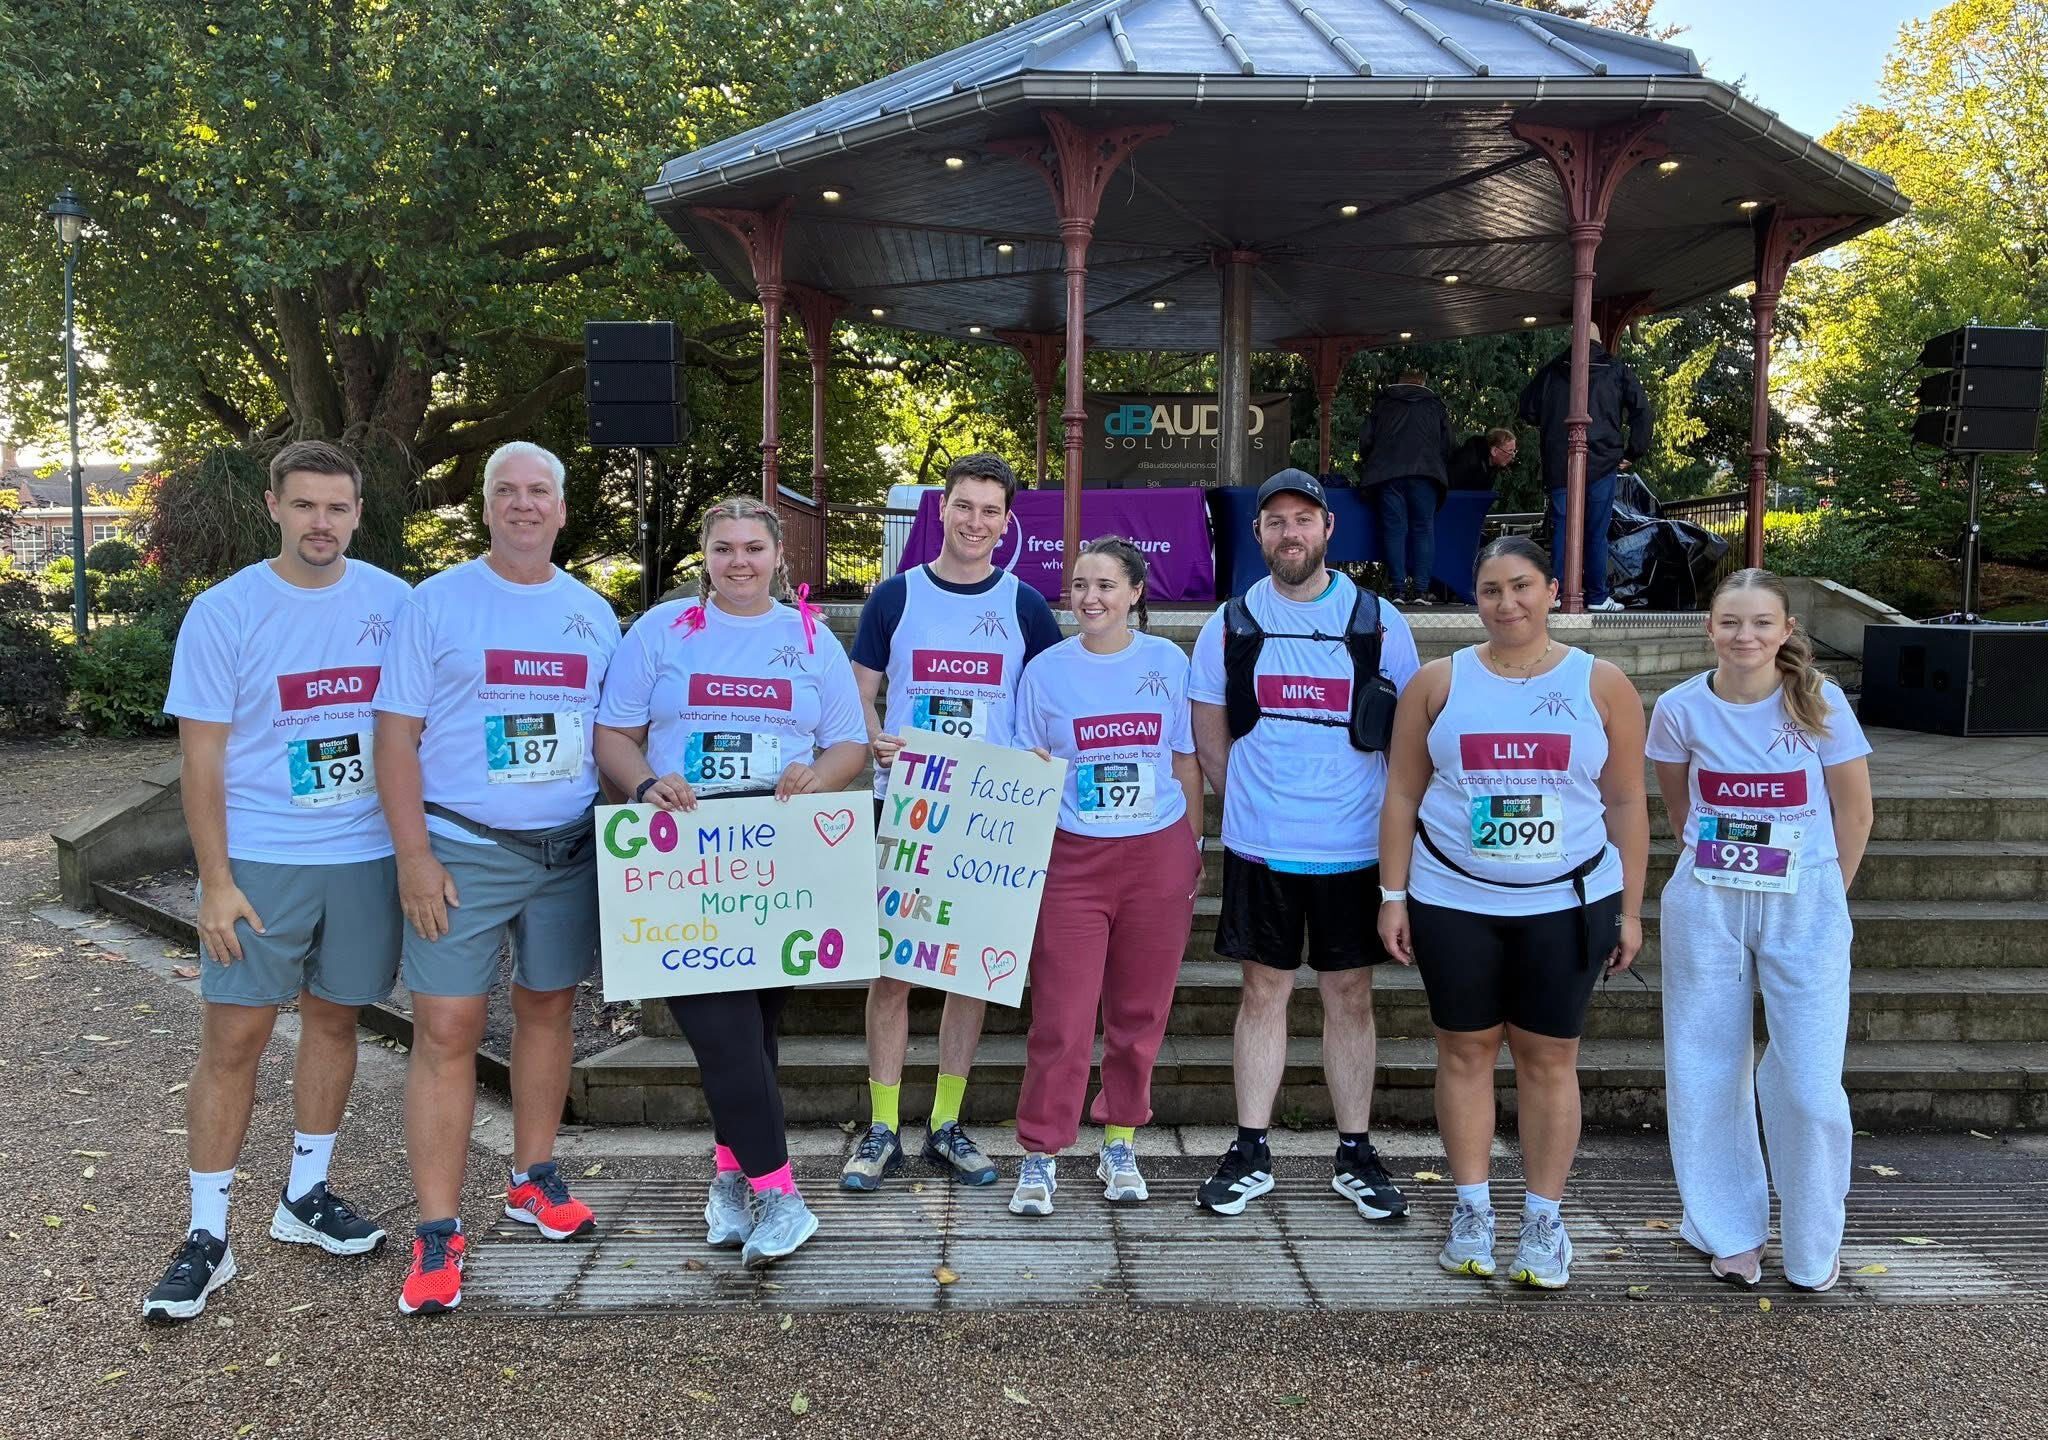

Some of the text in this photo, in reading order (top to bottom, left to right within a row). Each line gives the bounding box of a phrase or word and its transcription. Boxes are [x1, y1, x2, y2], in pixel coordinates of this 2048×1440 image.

[1104, 404, 1265, 436] dBAUDO
[1138, 461, 1217, 470] dBaudiosolutions.co
[513, 659, 564, 677] MIKE
[927, 658, 989, 675] JACOB
[306, 676, 363, 699] BRAD
[477, 689, 591, 704] katharine house hospi
[706, 682, 778, 699] CESCA
[906, 686, 1007, 700] katharine house hospice
[1282, 684, 1326, 702] MIKE
[272, 713, 320, 728] katharne
[324, 710, 355, 721] house
[679, 711, 797, 727] katharine house hospice
[1080, 721, 1158, 741] MORGAN
[507, 738, 559, 765] 187
[1075, 753, 1111, 764] atharine
[1114, 751, 1139, 760] house
[1494, 742, 1539, 759] LILY
[311, 759, 364, 790] 193
[700, 755, 751, 780] 851
[898, 751, 1056, 807] THE faster
[1506, 775, 1537, 785] house
[1541, 776, 1574, 787] hopice
[1717, 782, 1786, 798] AOIFE
[1095, 785, 1141, 808] 197
[892, 793, 1016, 845] YOU run
[1741, 811, 1775, 822] house
[1779, 808, 1817, 822] hospice
[603, 808, 776, 859] GO Mike
[1480, 820, 1555, 846] 2090
[877, 836, 1047, 889] THE sooner
[1720, 844, 1759, 872] 93
[624, 855, 776, 893] Bradley
[701, 888, 813, 926] Morgan
[622, 917, 719, 944] Jacob
[781, 928, 844, 976] GO
